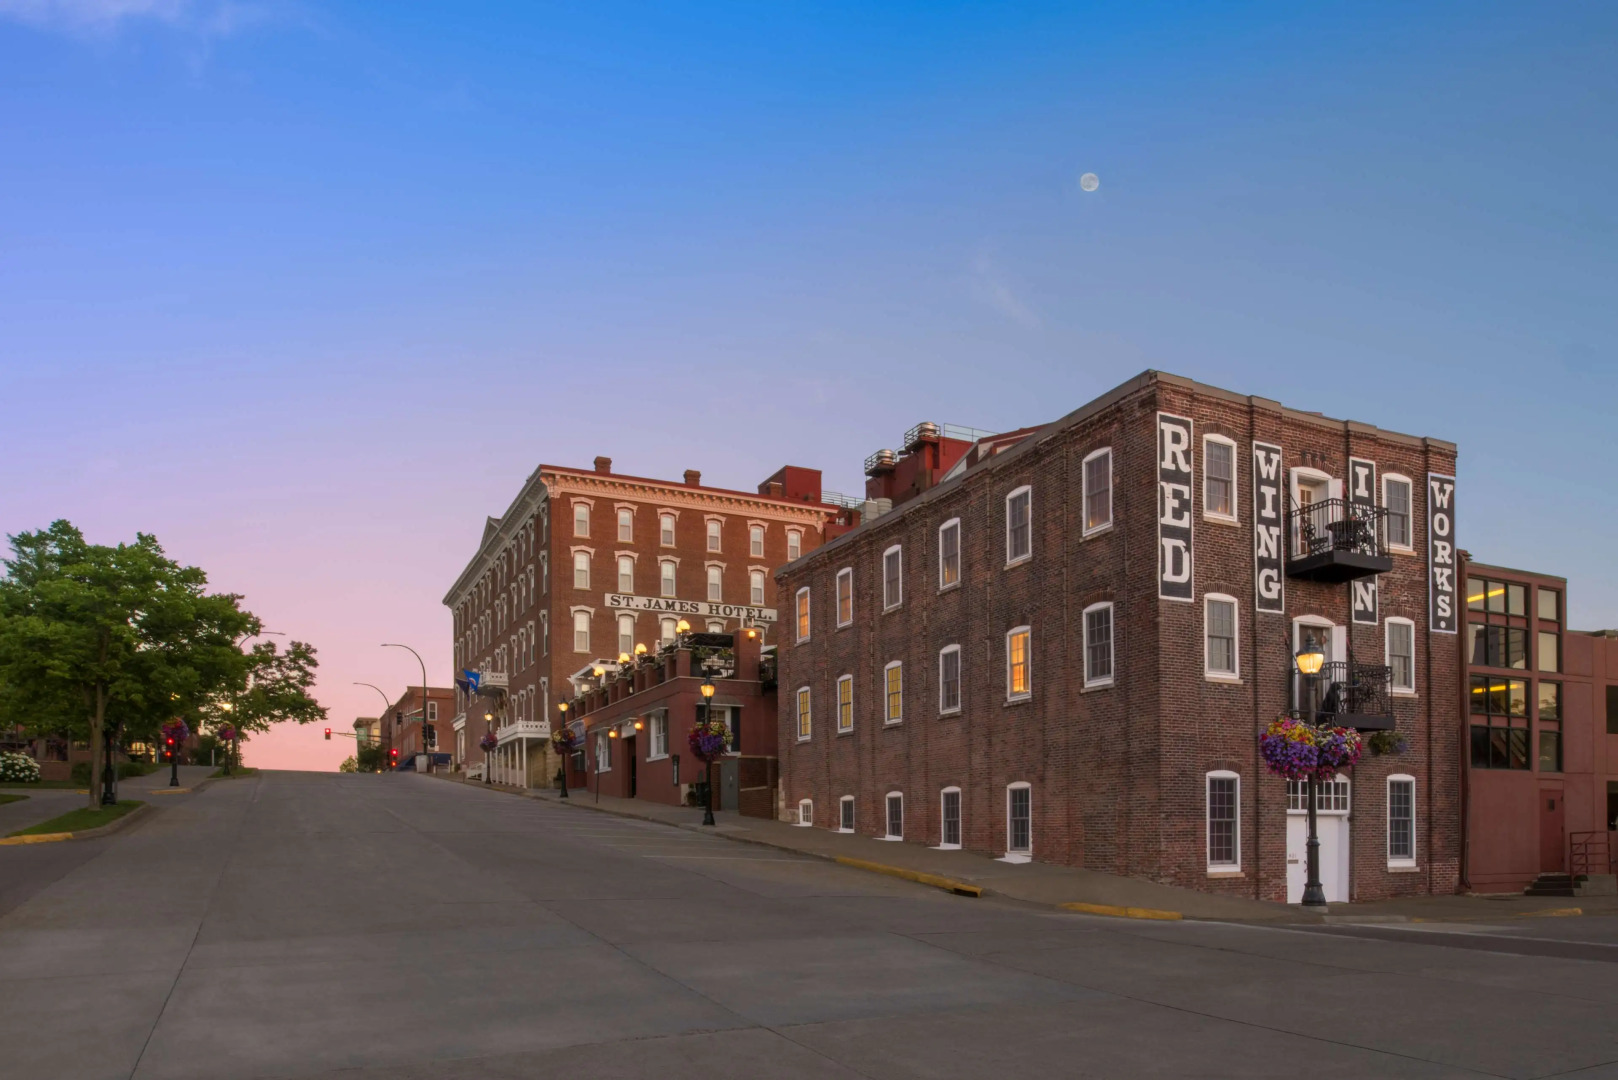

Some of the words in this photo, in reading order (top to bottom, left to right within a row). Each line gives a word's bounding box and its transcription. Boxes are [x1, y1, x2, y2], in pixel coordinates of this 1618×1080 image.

[1160, 422, 1191, 583] RED
[1255, 449, 1281, 600] WING
[1354, 465, 1376, 613] IN
[610, 594, 639, 608] ST.
[643, 598, 700, 613] JAMES
[708, 604, 773, 620] HOTEL.
